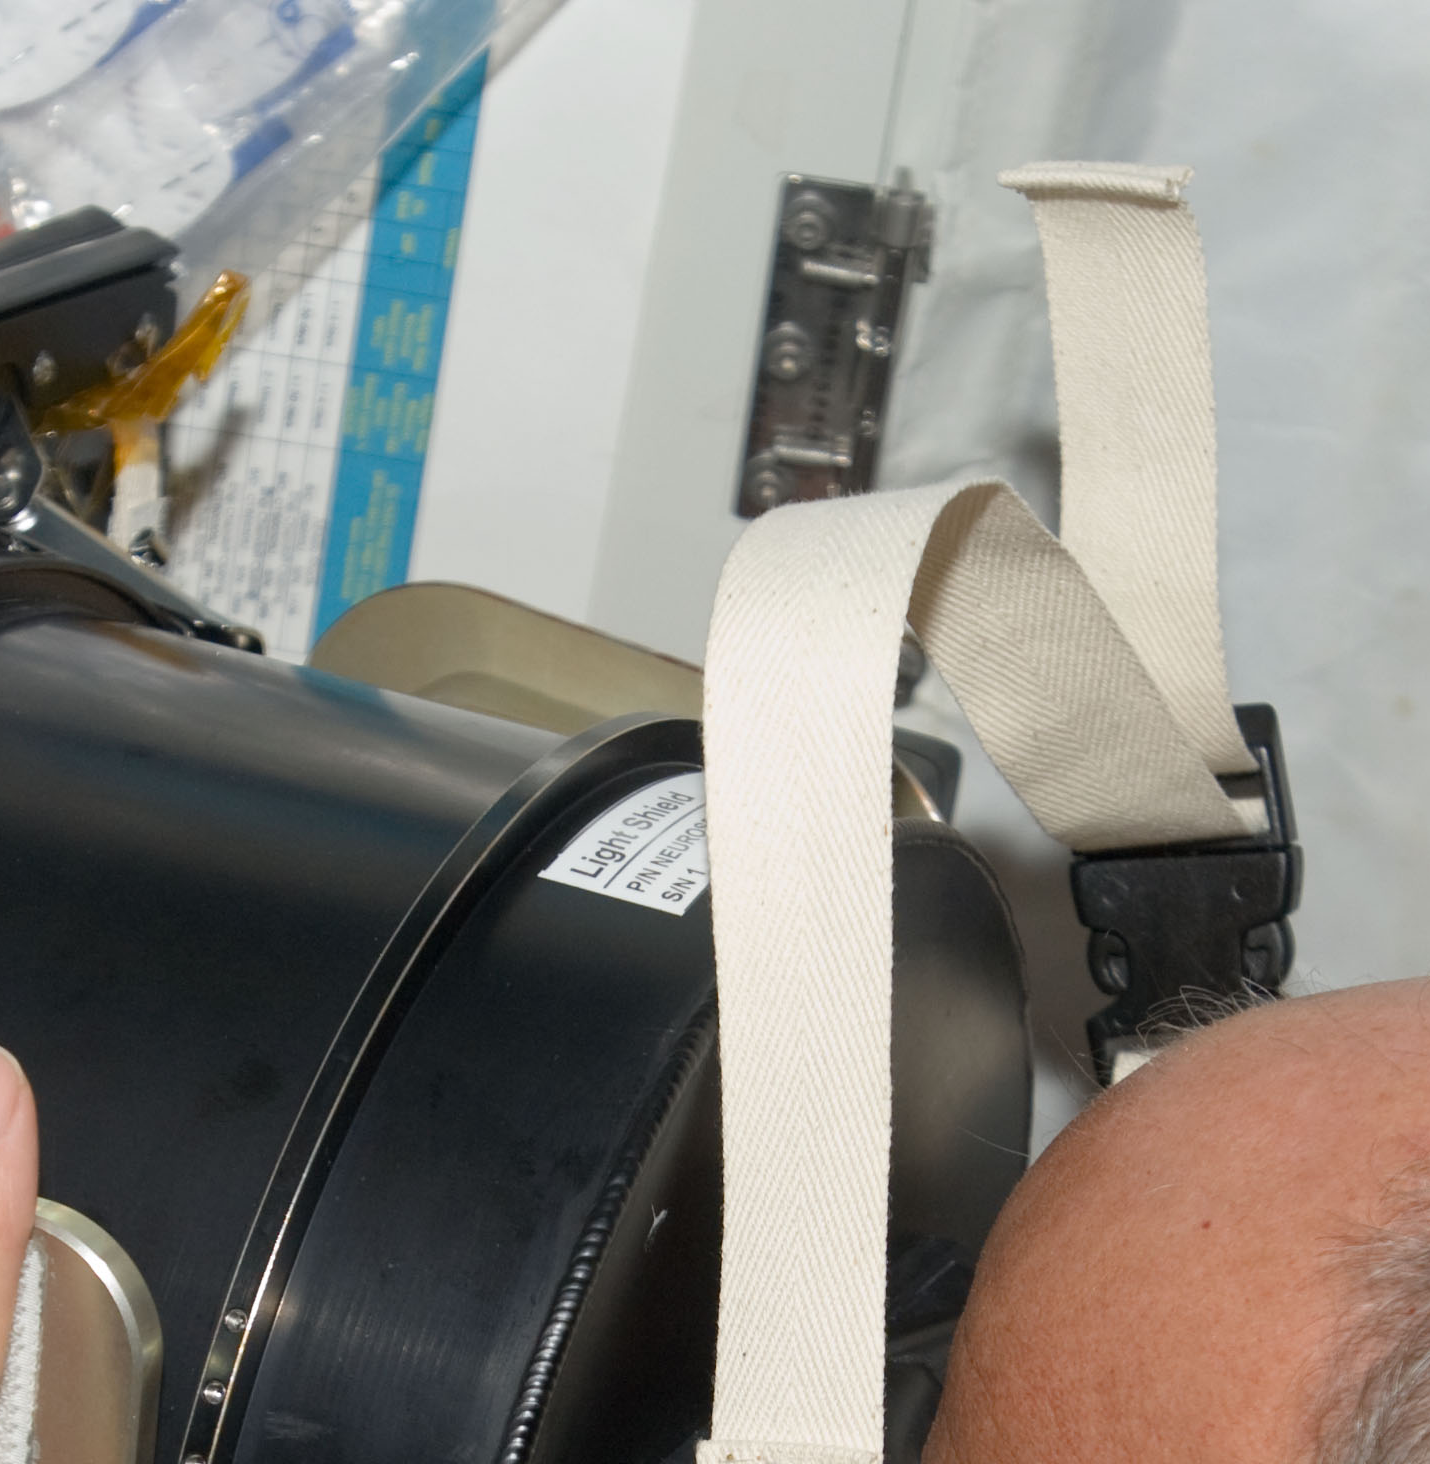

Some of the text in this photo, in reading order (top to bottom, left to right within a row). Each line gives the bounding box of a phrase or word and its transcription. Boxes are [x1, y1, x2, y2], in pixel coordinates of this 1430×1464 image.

[570, 790, 696, 879] Light Shield
[626, 867, 662, 893] P/N
[661, 865, 707, 903] S/N 1
